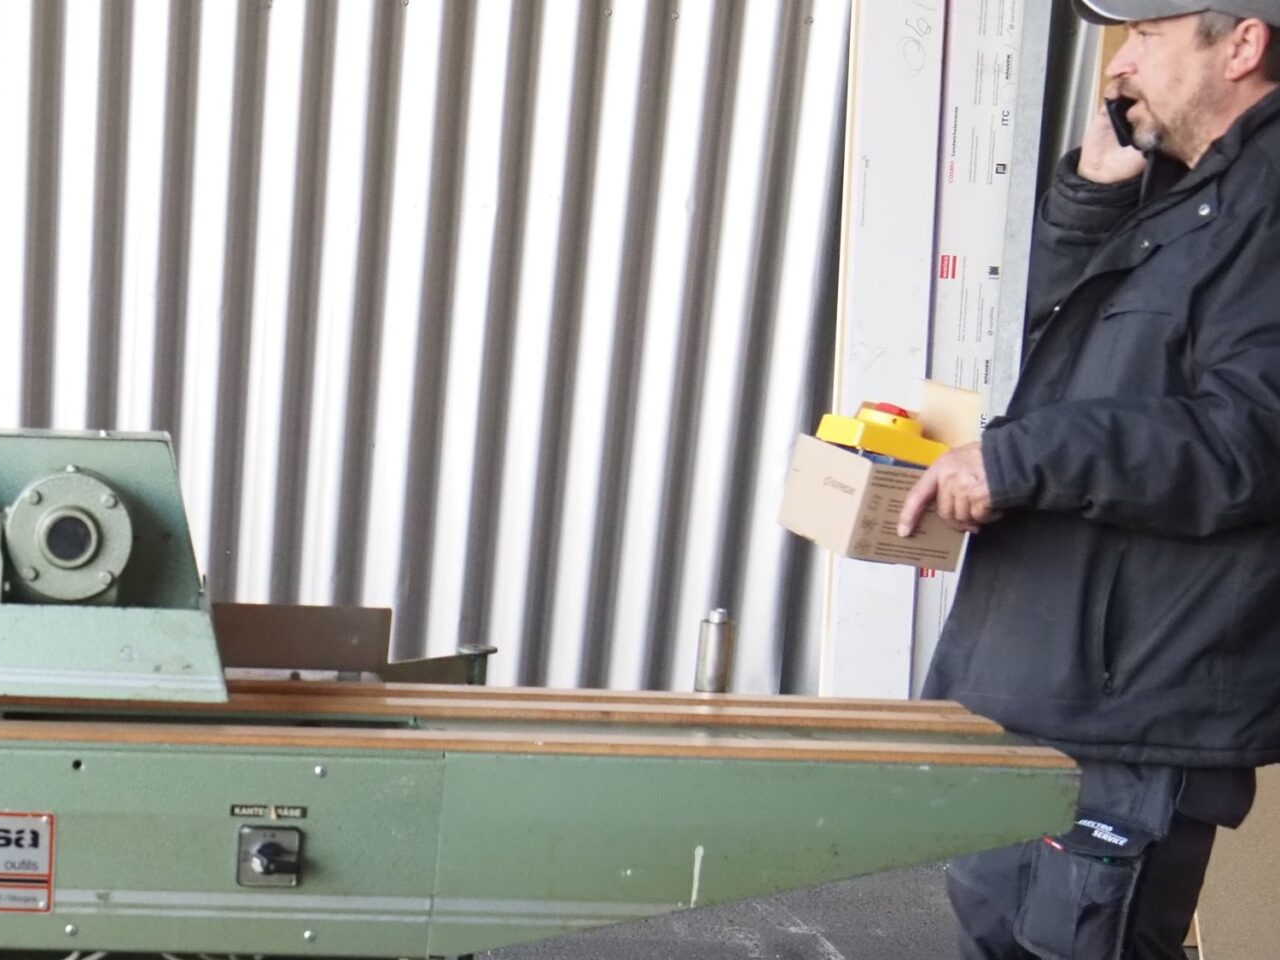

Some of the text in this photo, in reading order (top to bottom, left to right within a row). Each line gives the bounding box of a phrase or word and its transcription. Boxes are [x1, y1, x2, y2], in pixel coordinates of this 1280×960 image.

[1000, 110, 1010, 127] ITC
[1091, 829, 1128, 847] SERVICE
[4, 859, 39, 871] outils
